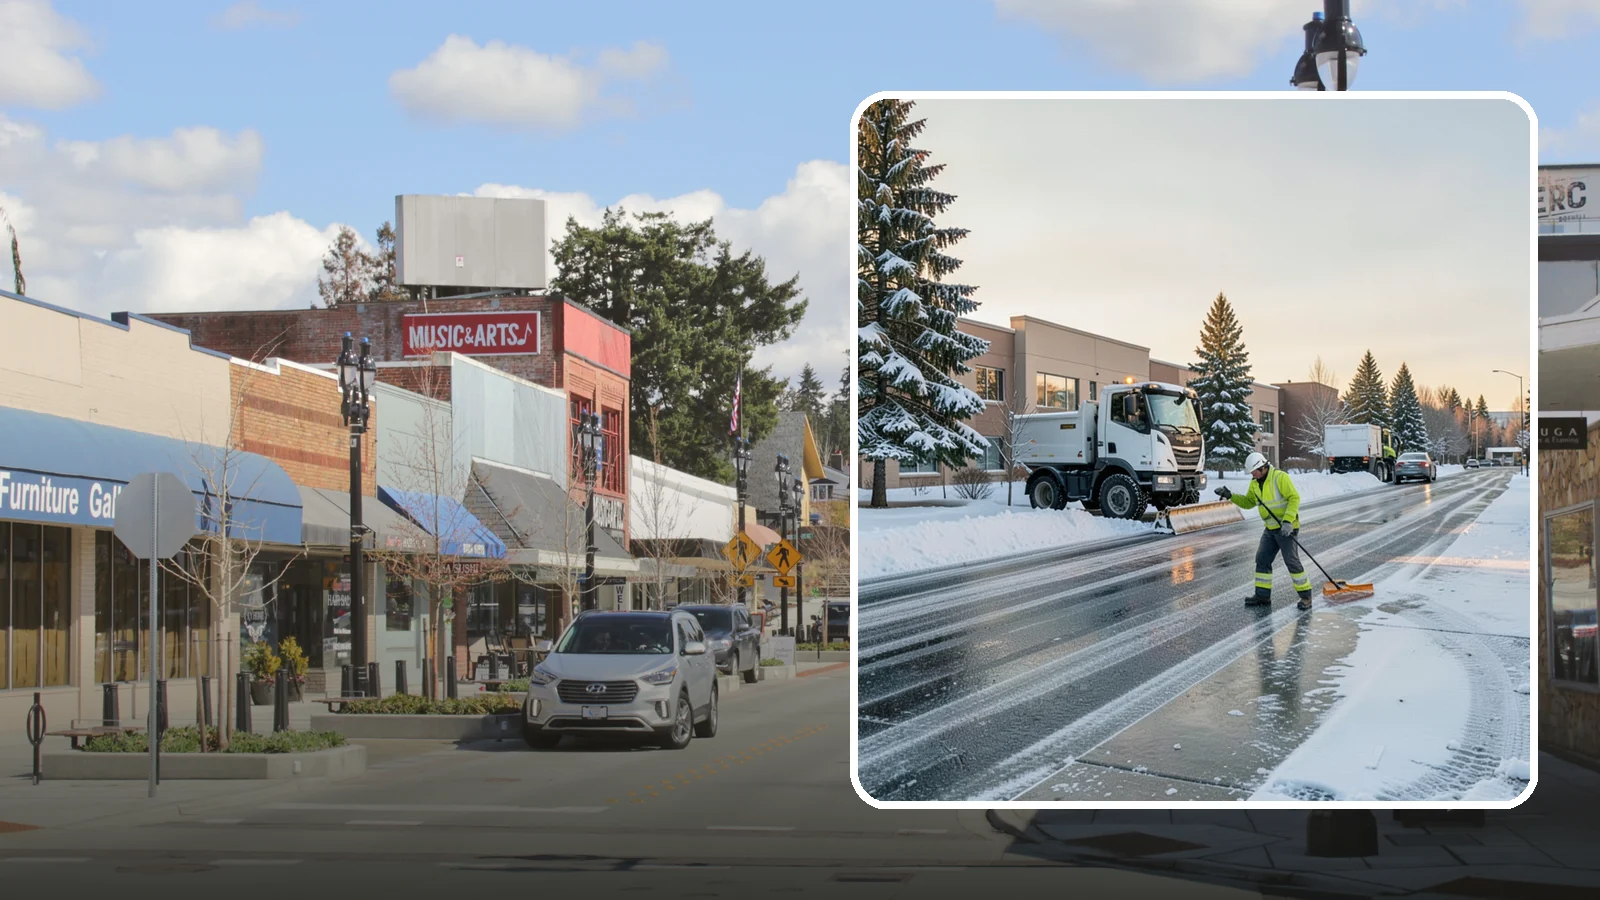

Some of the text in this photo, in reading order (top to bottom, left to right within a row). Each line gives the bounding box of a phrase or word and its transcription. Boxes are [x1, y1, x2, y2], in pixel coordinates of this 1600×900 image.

[409, 322, 519, 349] MUSIC&ARTS
[0, 471, 122, 519] Furniture Gal
